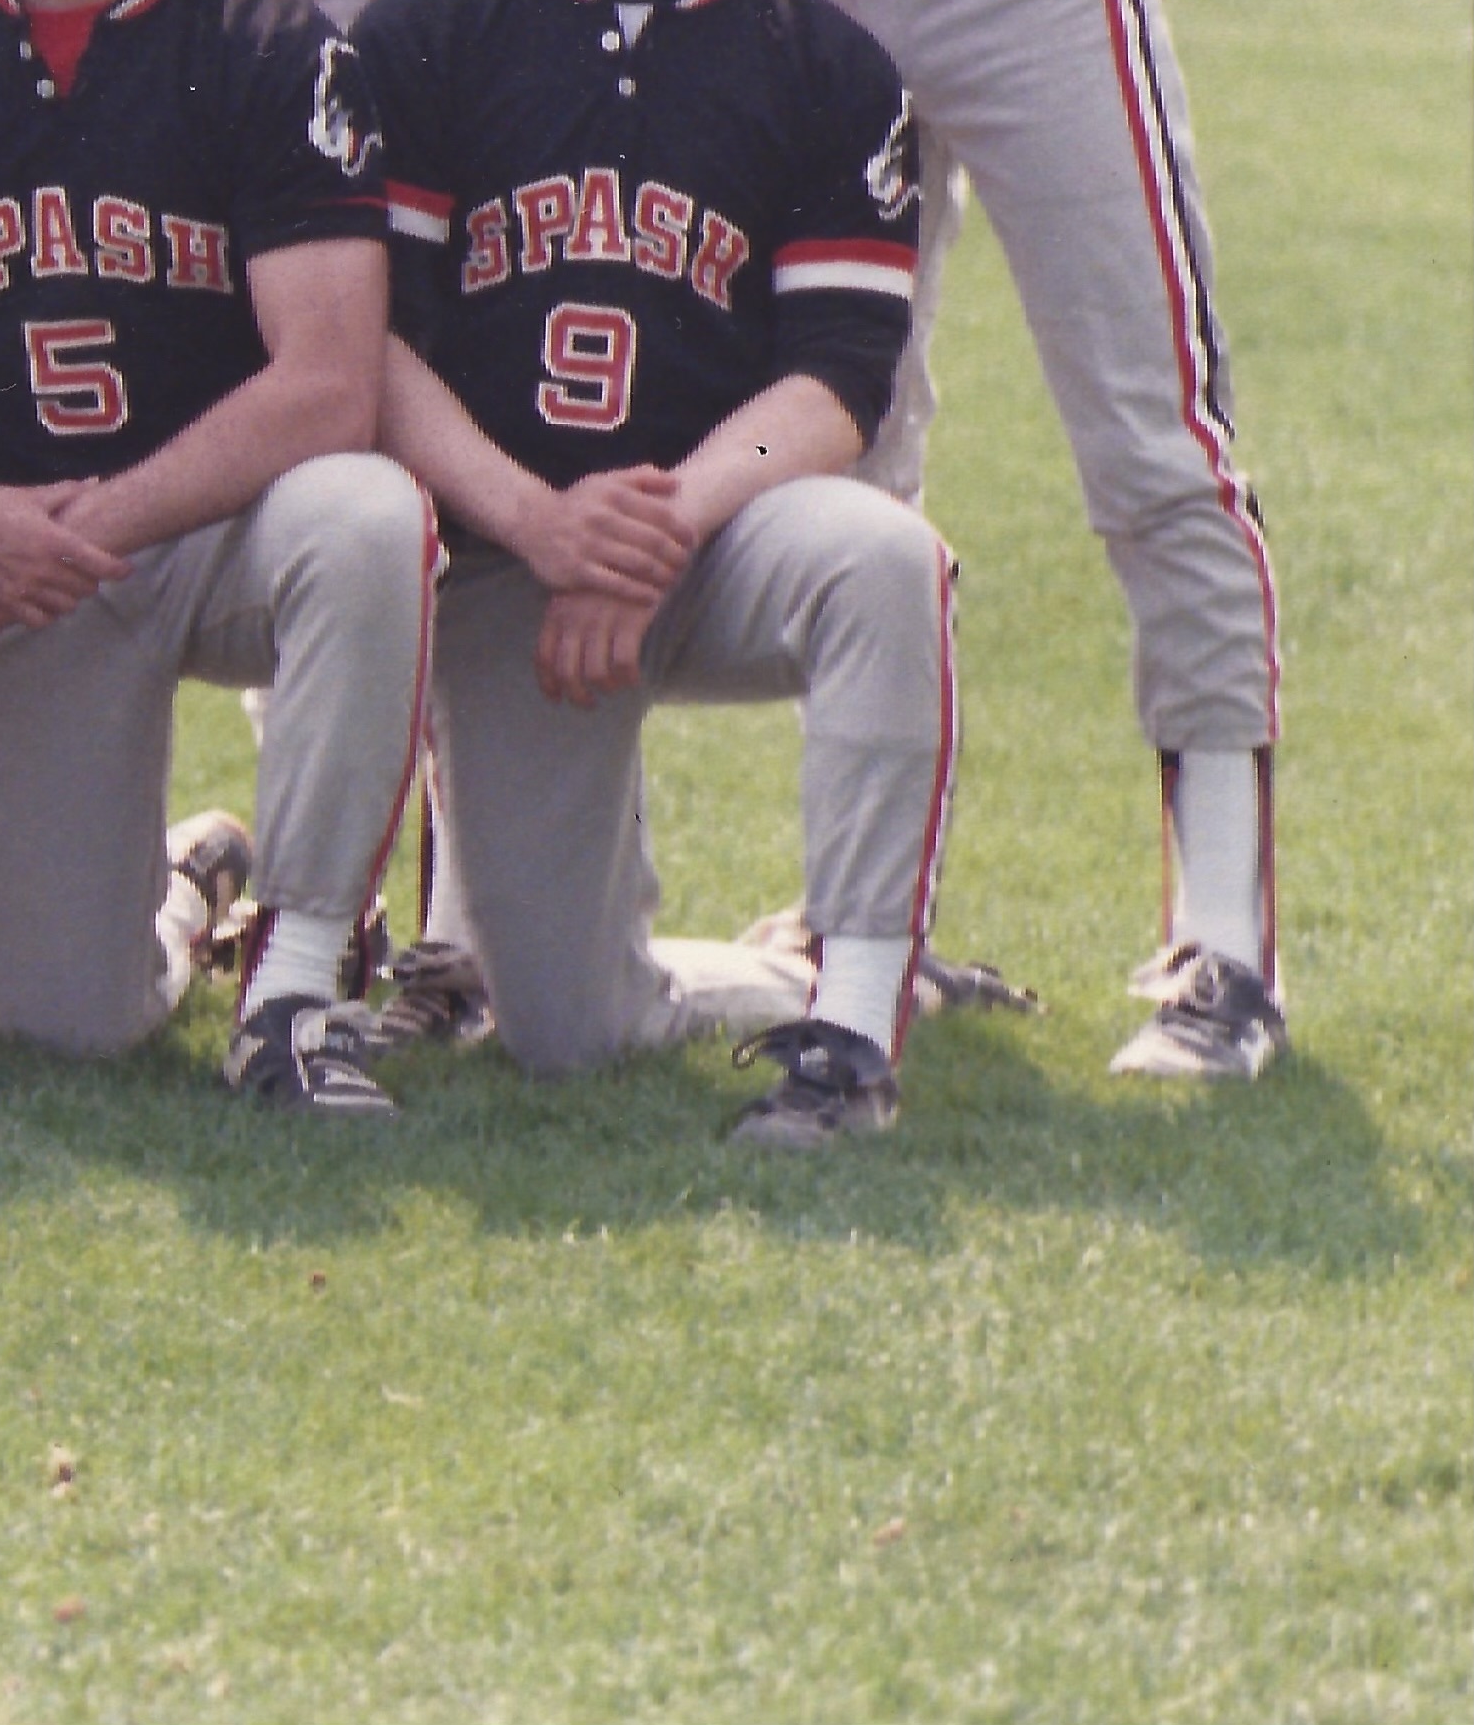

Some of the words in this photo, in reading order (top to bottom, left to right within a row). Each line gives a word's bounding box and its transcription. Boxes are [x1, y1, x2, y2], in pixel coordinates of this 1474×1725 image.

[462, 167, 750, 310] SPASH
[23, 320, 127, 436] 5
[538, 304, 636, 431] 9
